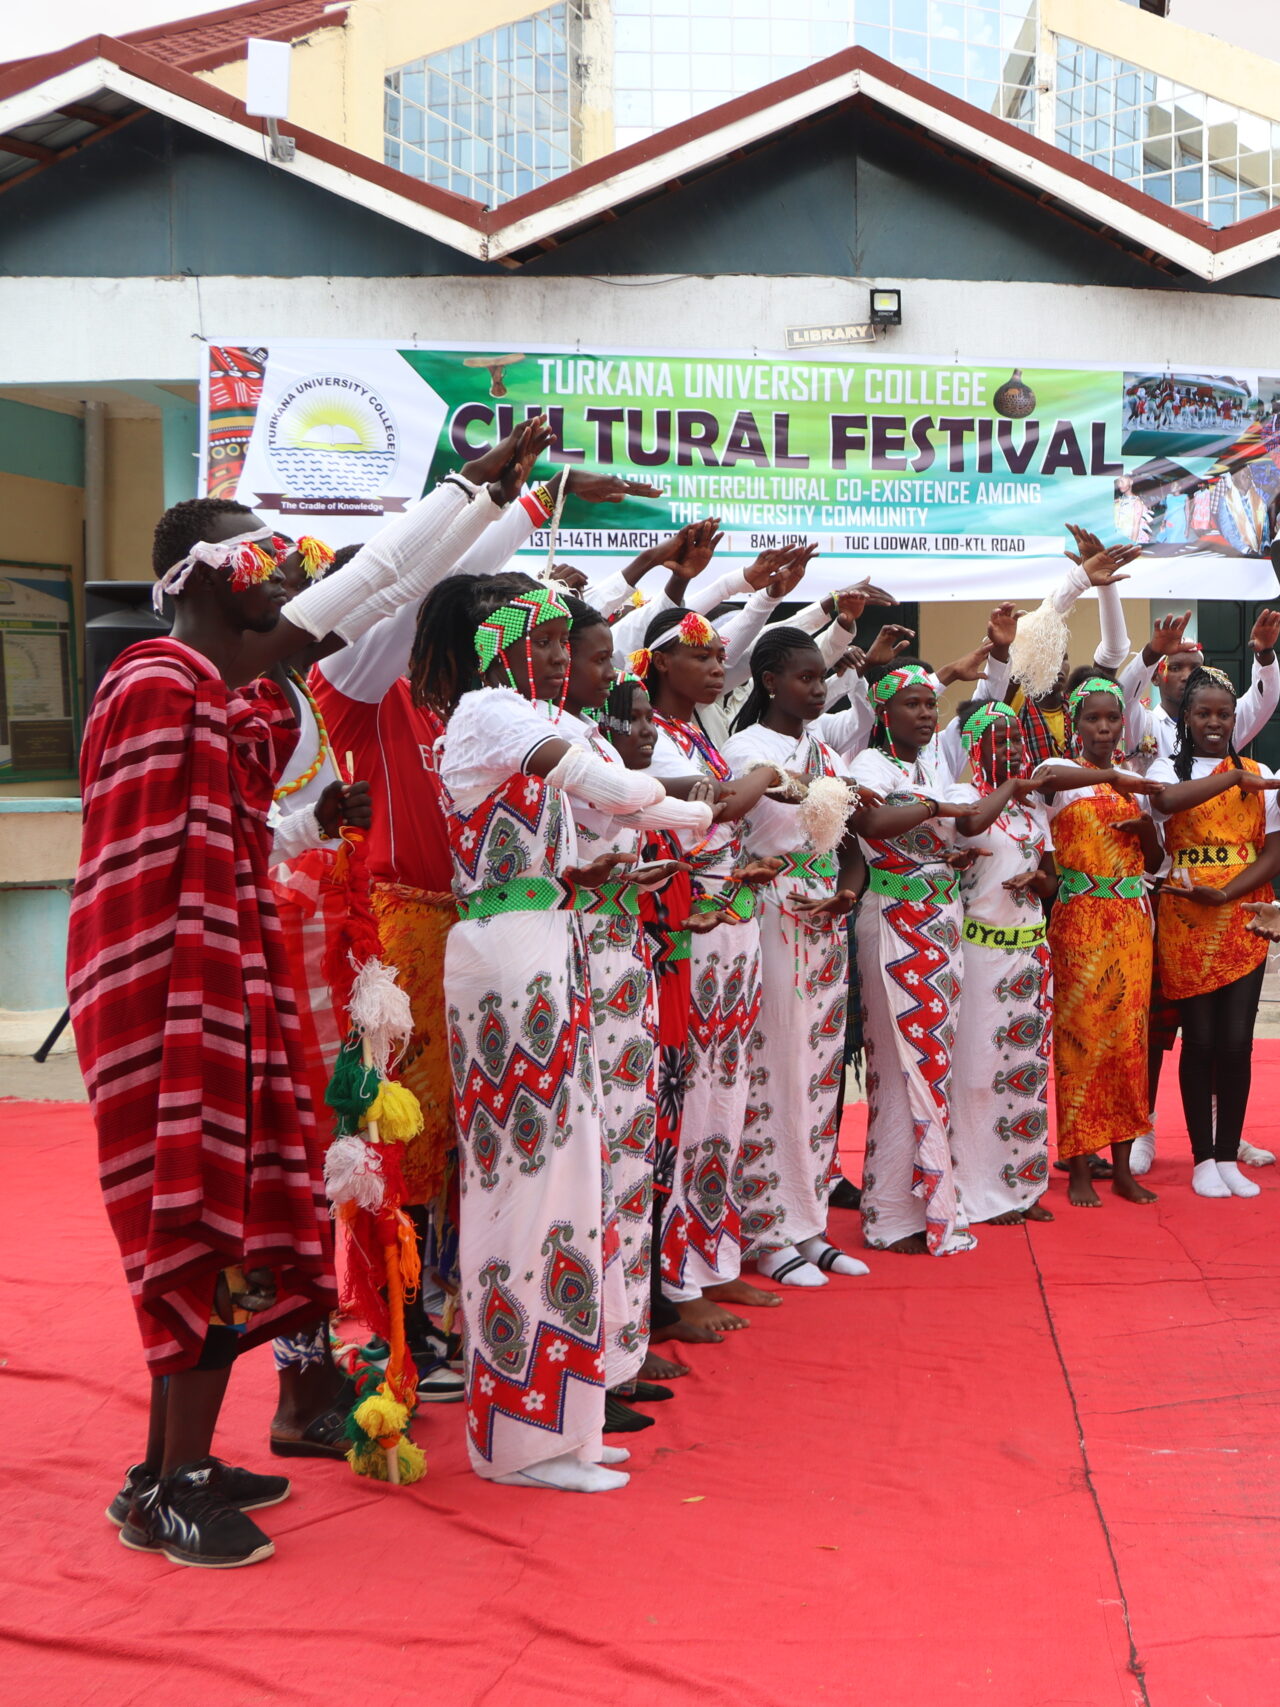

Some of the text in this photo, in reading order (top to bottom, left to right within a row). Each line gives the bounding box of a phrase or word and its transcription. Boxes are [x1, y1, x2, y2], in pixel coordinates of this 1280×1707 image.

[792, 325, 868, 343] LIBRARY
[537, 358, 988, 407] TURKANA UNIVERSITY COLLEGE
[268, 377, 396, 450] TURKANA UNIVERSITY COLLEGE
[449, 402, 1124, 477] CULTURAL FESTIVAL
[678, 474, 830, 501] INTERCULTURAL
[836, 478, 970, 504] CO-EXISTENCE
[976, 481, 1042, 504] AMONG
[281, 501, 384, 512] The Cradle of Knowledge
[668, 502, 929, 527] THE UNIVERSITY COMMUNITY
[607, 532, 658, 548] MARCH
[845, 536, 869, 550] TUC
[874, 537, 931, 552] LODWAR,
[935, 538, 988, 551] LOD-KTL
[991, 539, 1026, 552] ROAD
